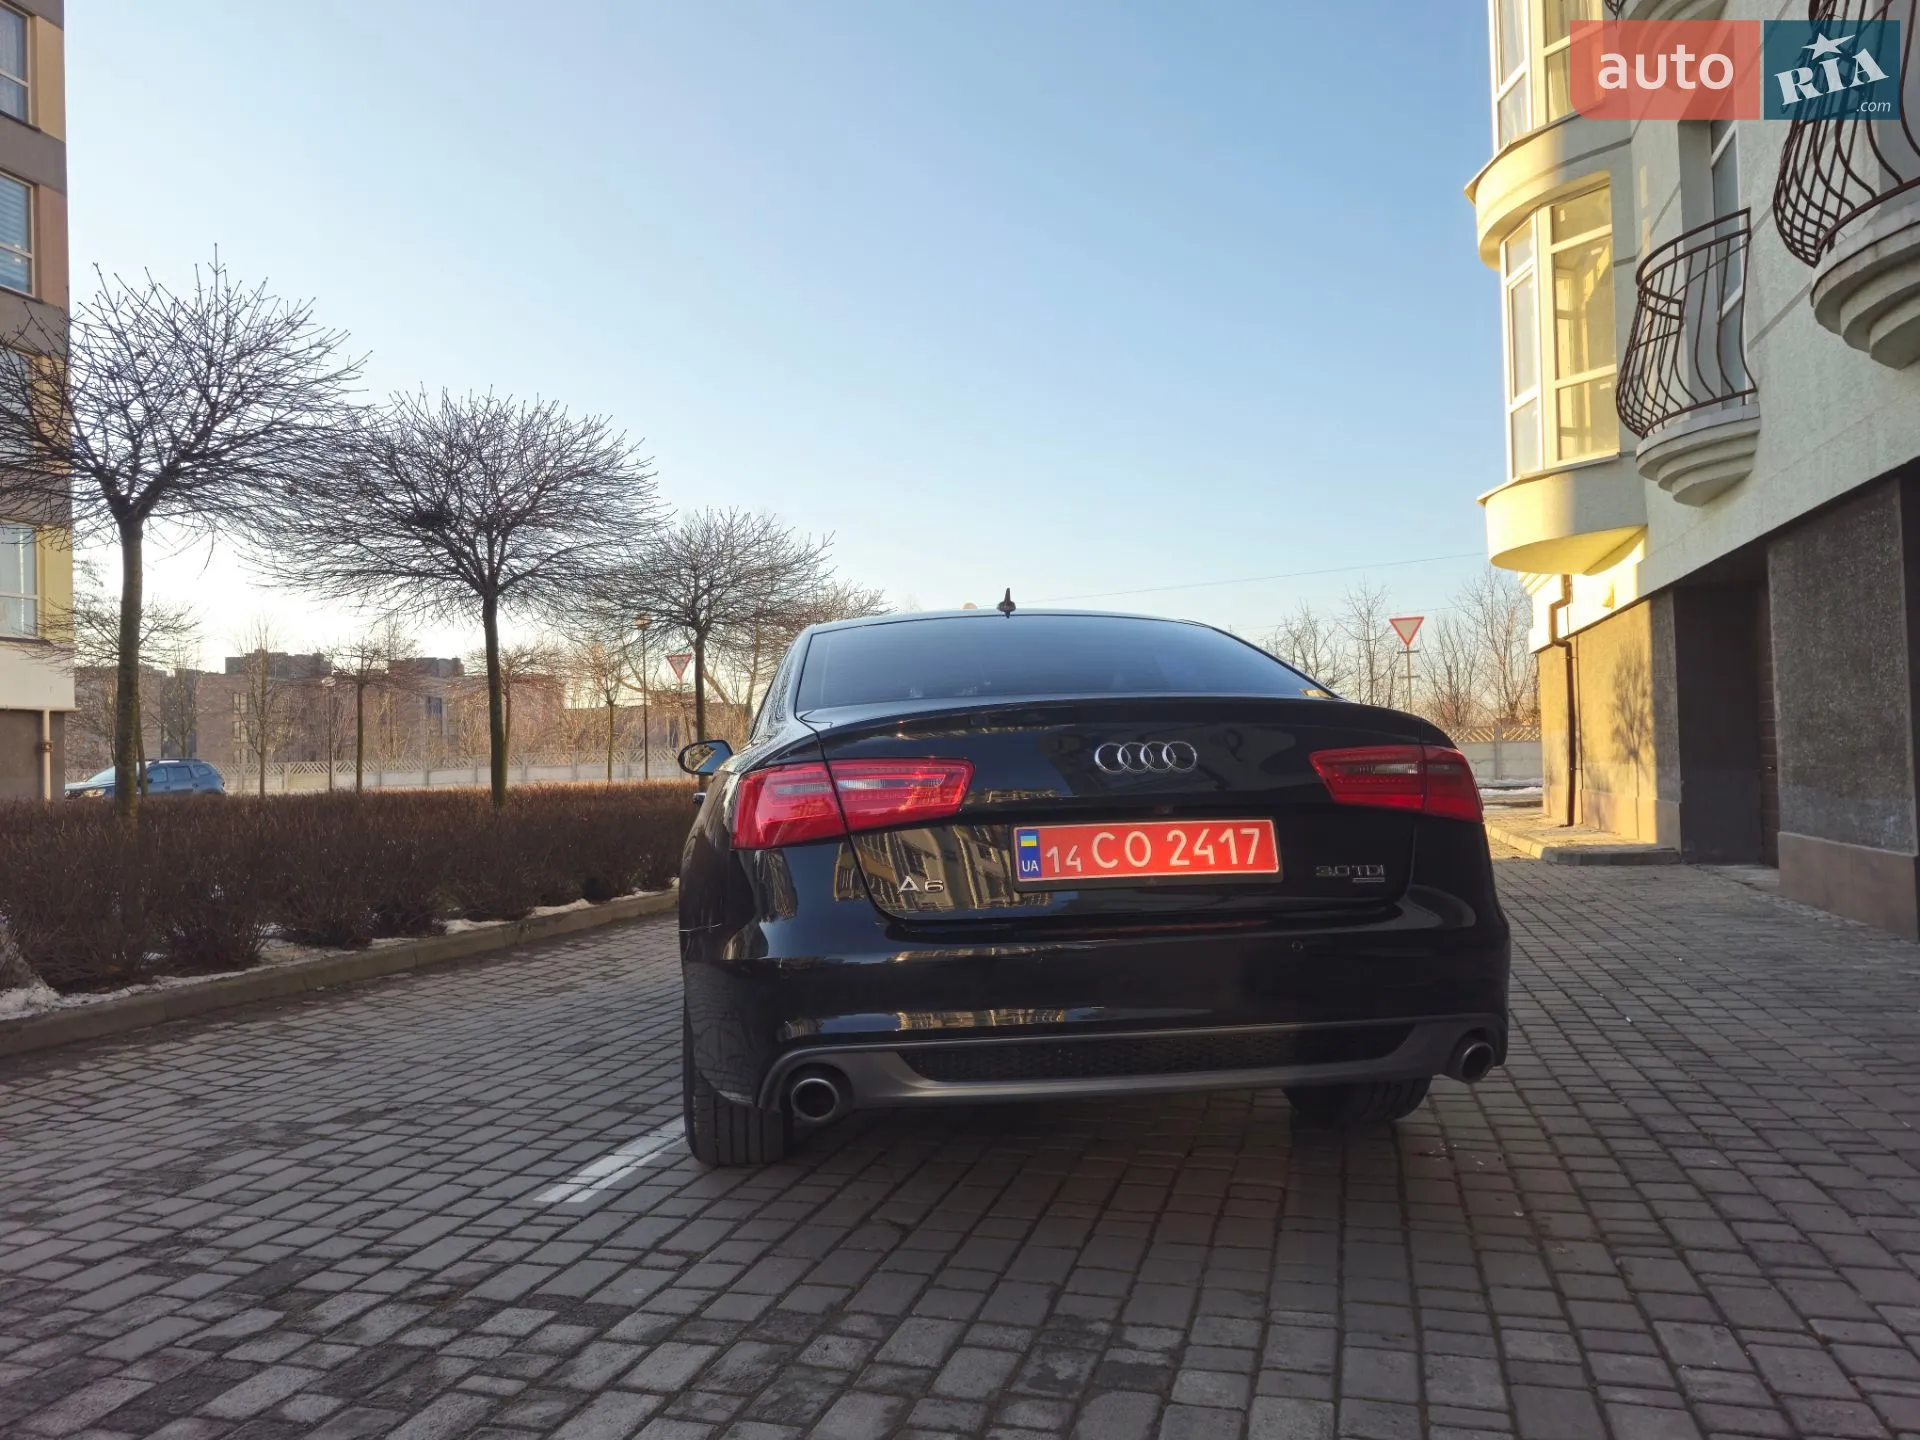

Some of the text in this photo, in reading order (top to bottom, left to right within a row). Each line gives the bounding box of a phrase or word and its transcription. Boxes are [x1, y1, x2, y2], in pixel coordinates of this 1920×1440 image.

[1046, 828, 1260, 873] 14 CO 2417
[1022, 860, 1039, 873] UA
[897, 875, 944, 894] A6
